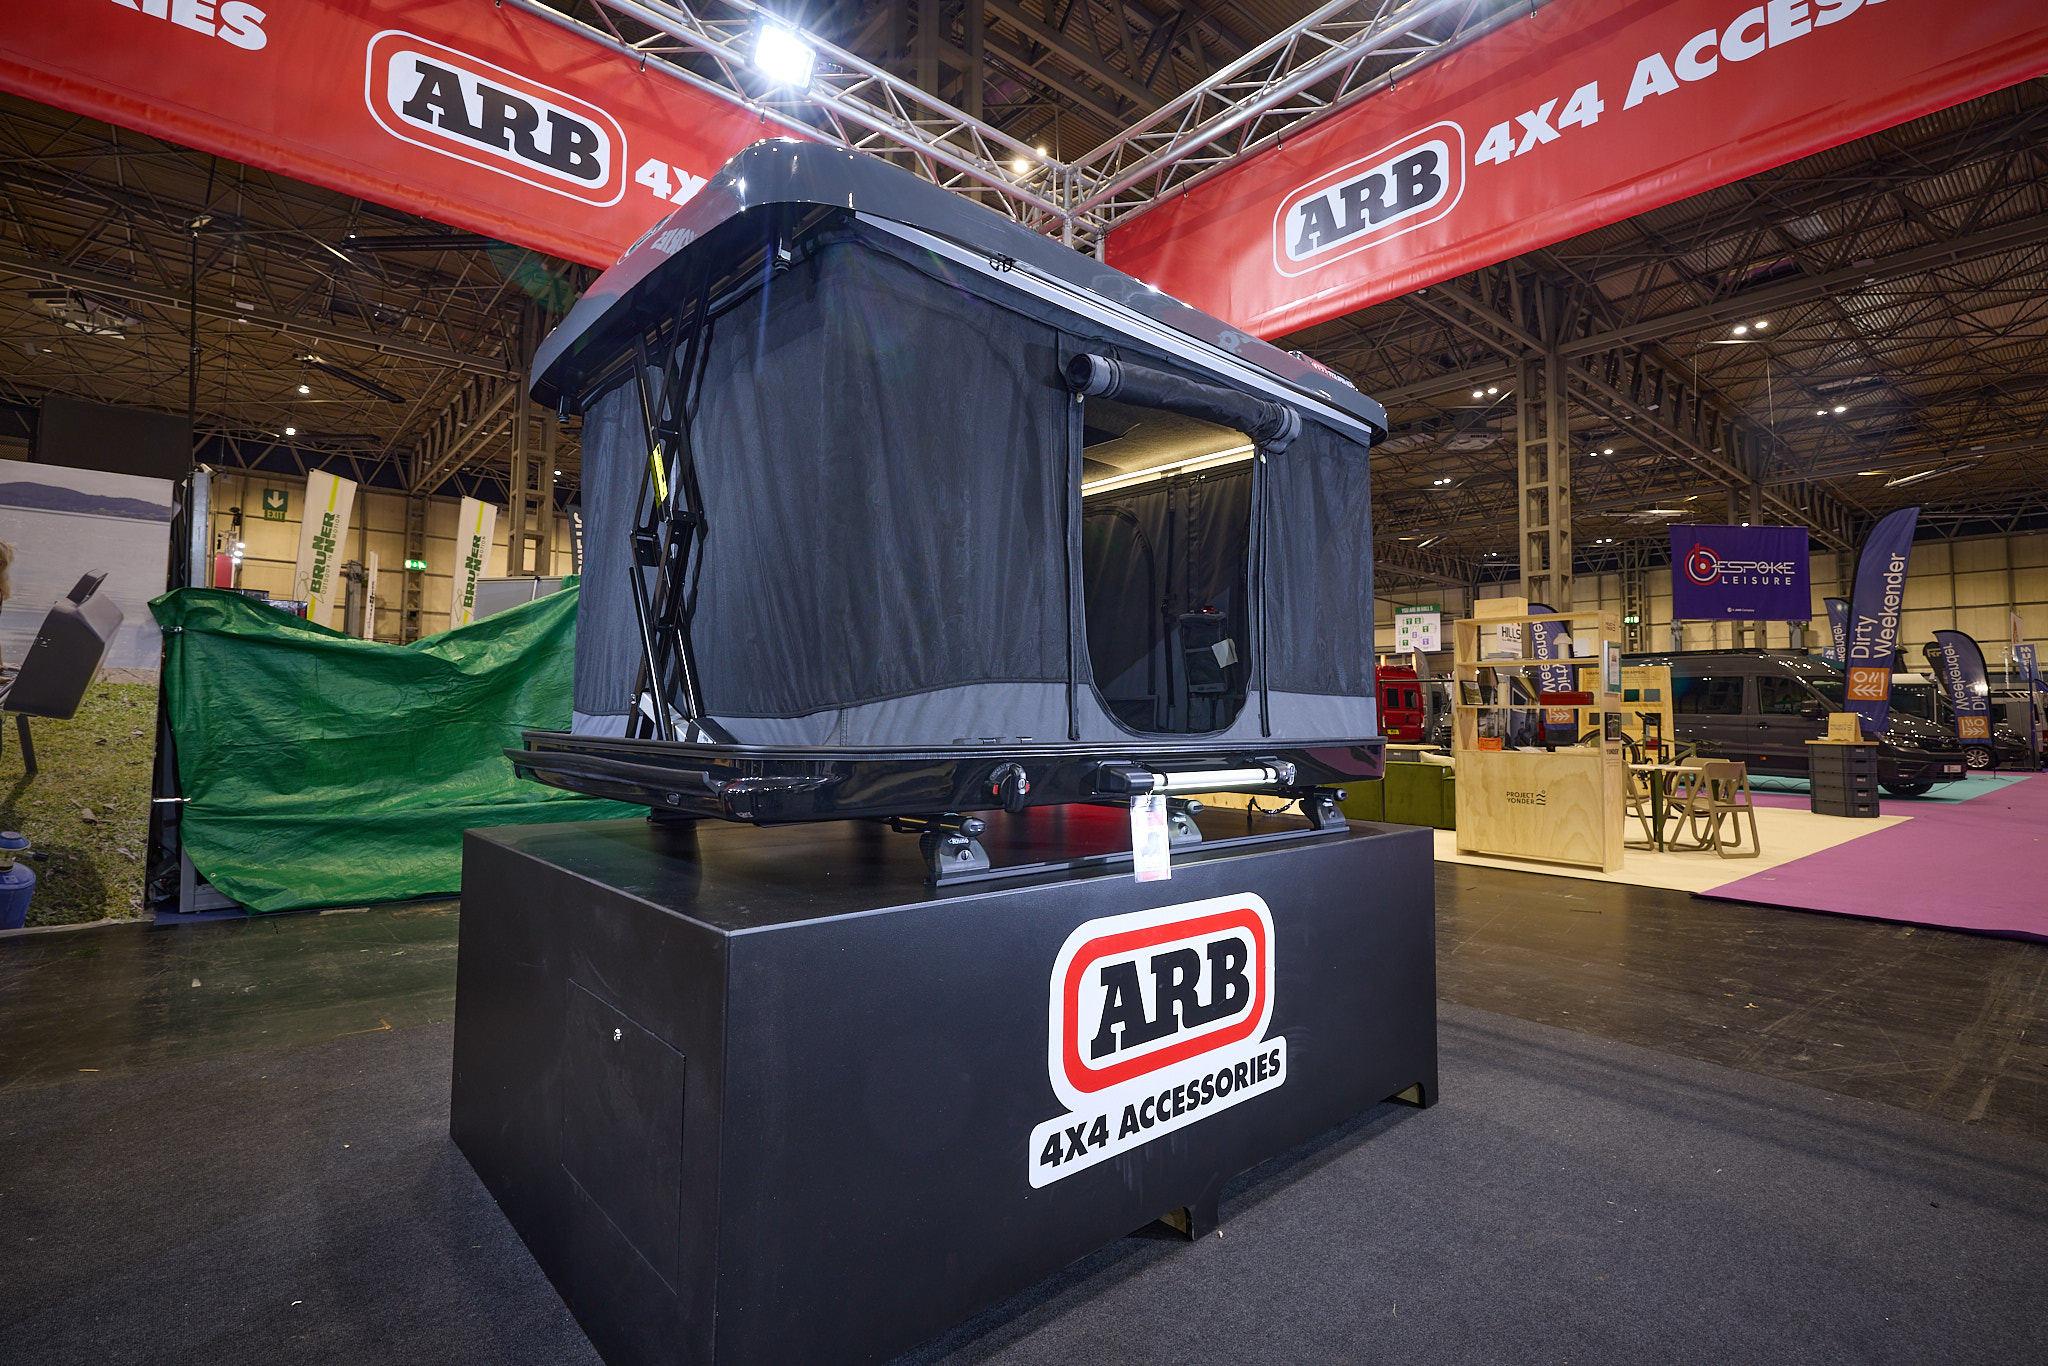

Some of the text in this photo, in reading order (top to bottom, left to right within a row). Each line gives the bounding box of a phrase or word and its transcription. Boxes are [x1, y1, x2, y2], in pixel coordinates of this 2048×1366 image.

[402, 59, 709, 206] ARB 4X
[1294, 149, 1442, 256] ARB
[1474, 81, 1605, 166] 4X4
[267, 510, 284, 520] EXIT
[332, 514, 341, 539] MOTION
[310, 512, 336, 594] BRUNNER
[463, 535, 482, 608] BRUNNER
[1722, 576, 1792, 586] LEISURE
[1501, 626, 1521, 640] HILLS
[1873, 553, 1906, 659] Weekender
[1851, 615, 1879, 659] Dirty
[1506, 791, 1535, 799] PROJECT
[1507, 797, 1535, 805] YONDER
[1091, 937, 1250, 1061] ARB
[1040, 1048, 1280, 1168] 4X4 ACCESSORIES
